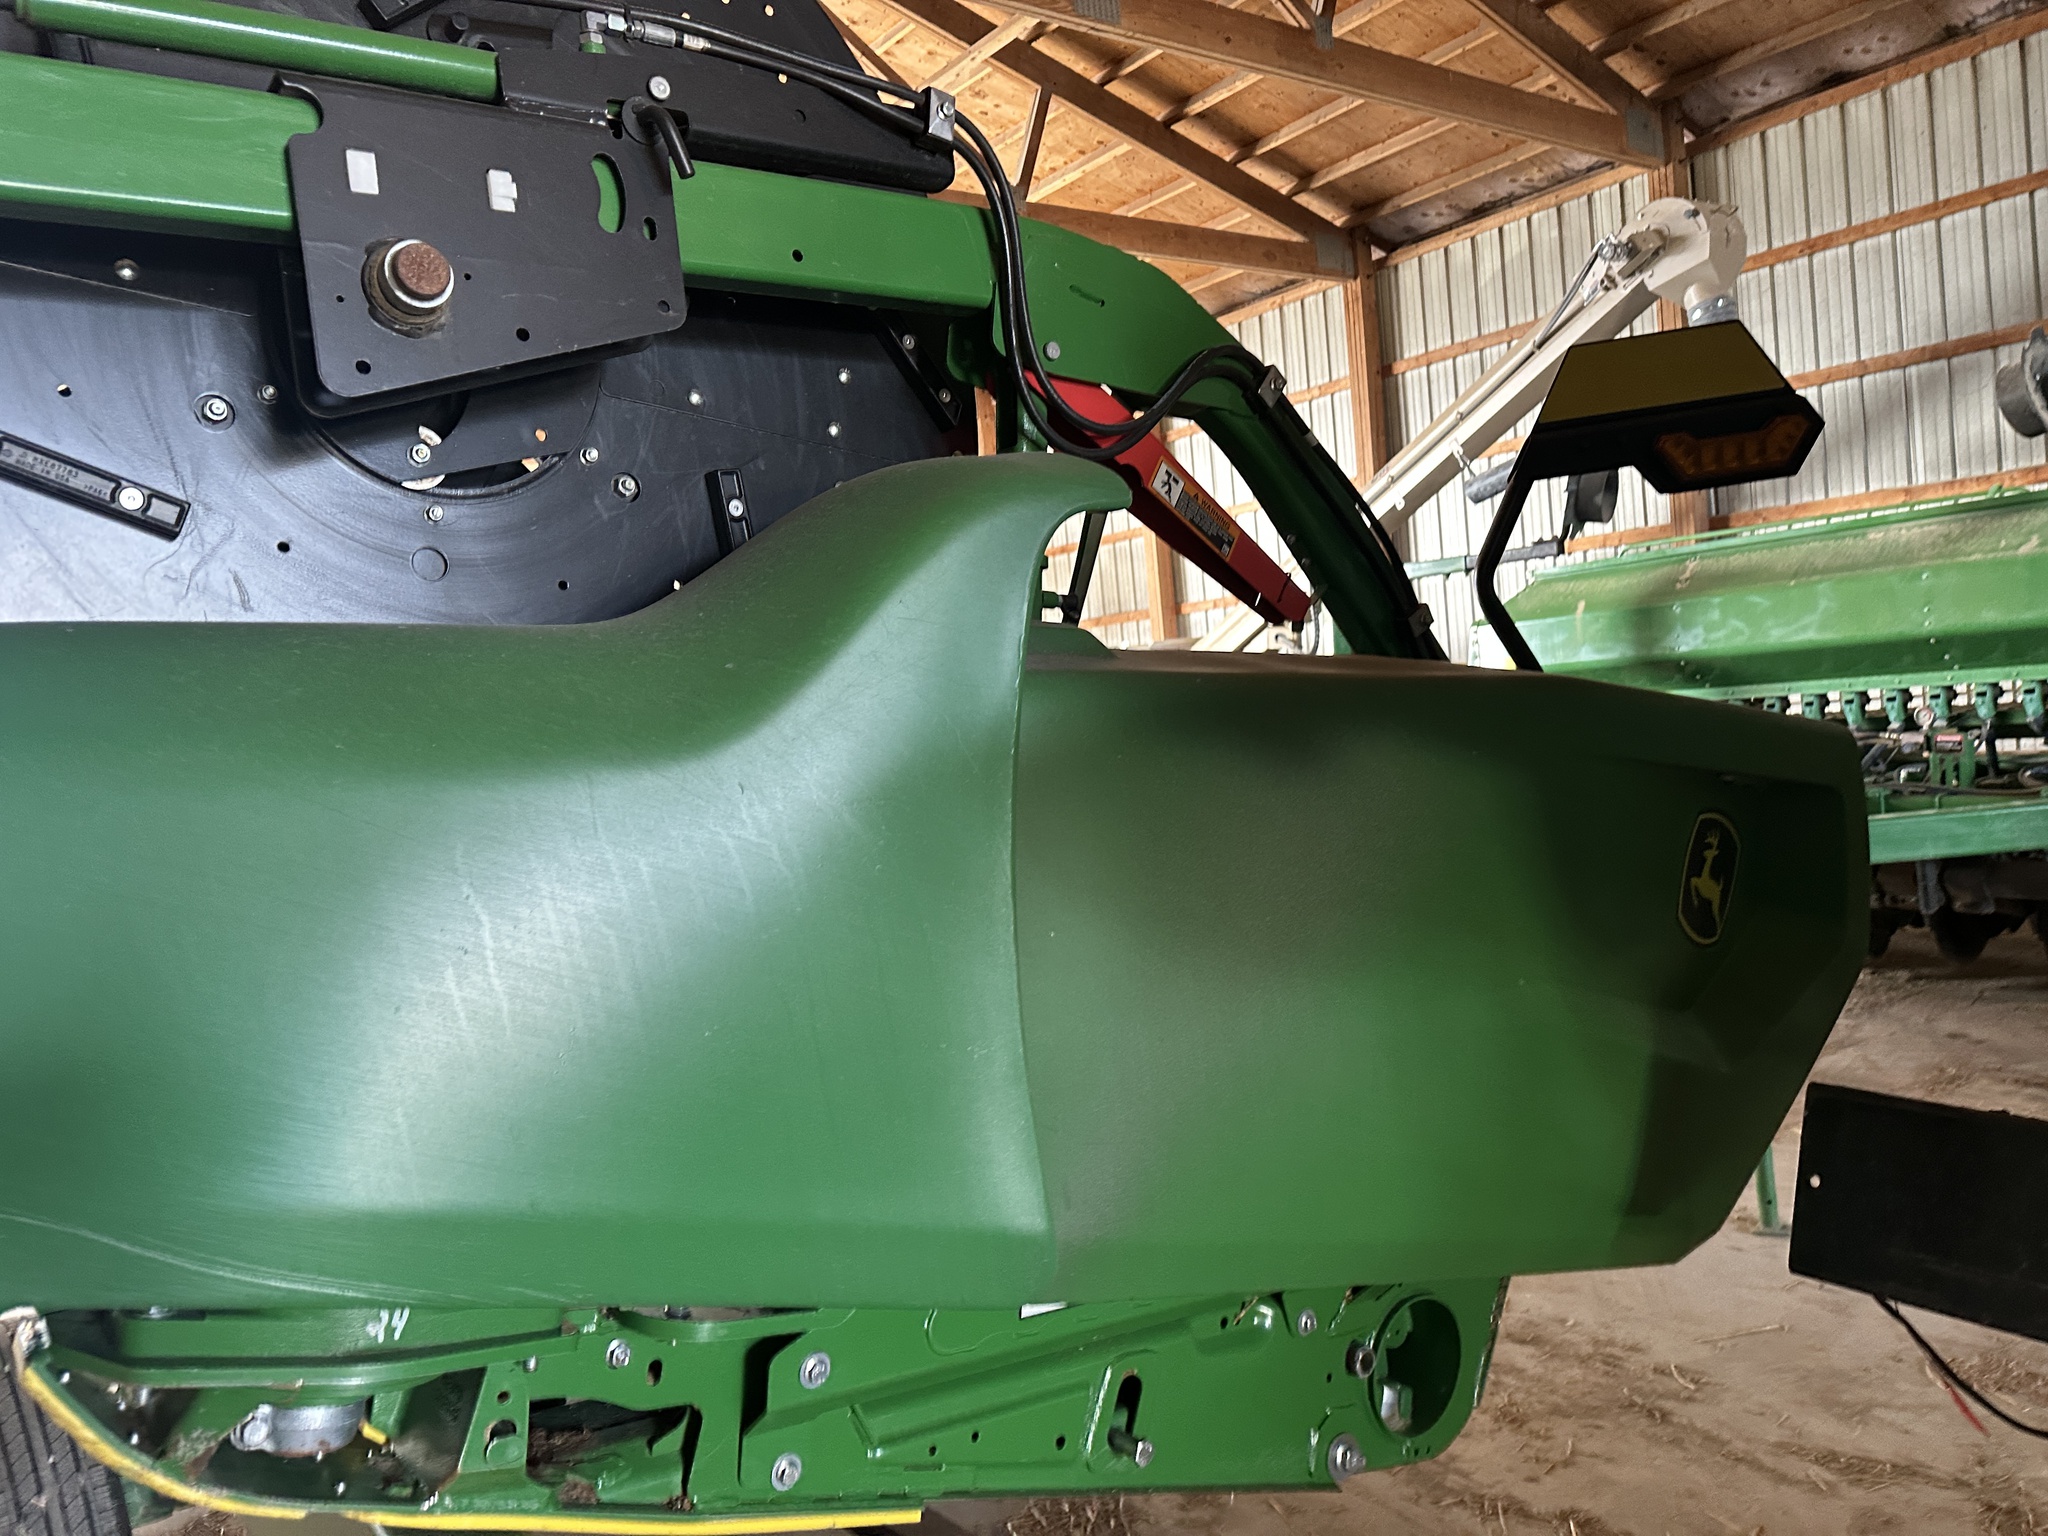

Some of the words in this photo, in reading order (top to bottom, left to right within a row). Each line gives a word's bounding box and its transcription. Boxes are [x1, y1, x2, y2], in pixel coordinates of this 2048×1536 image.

[15, 459, 36, 470] MADE
[55, 473, 70, 483] USA
[1201, 499, 1231, 530] WARNING
